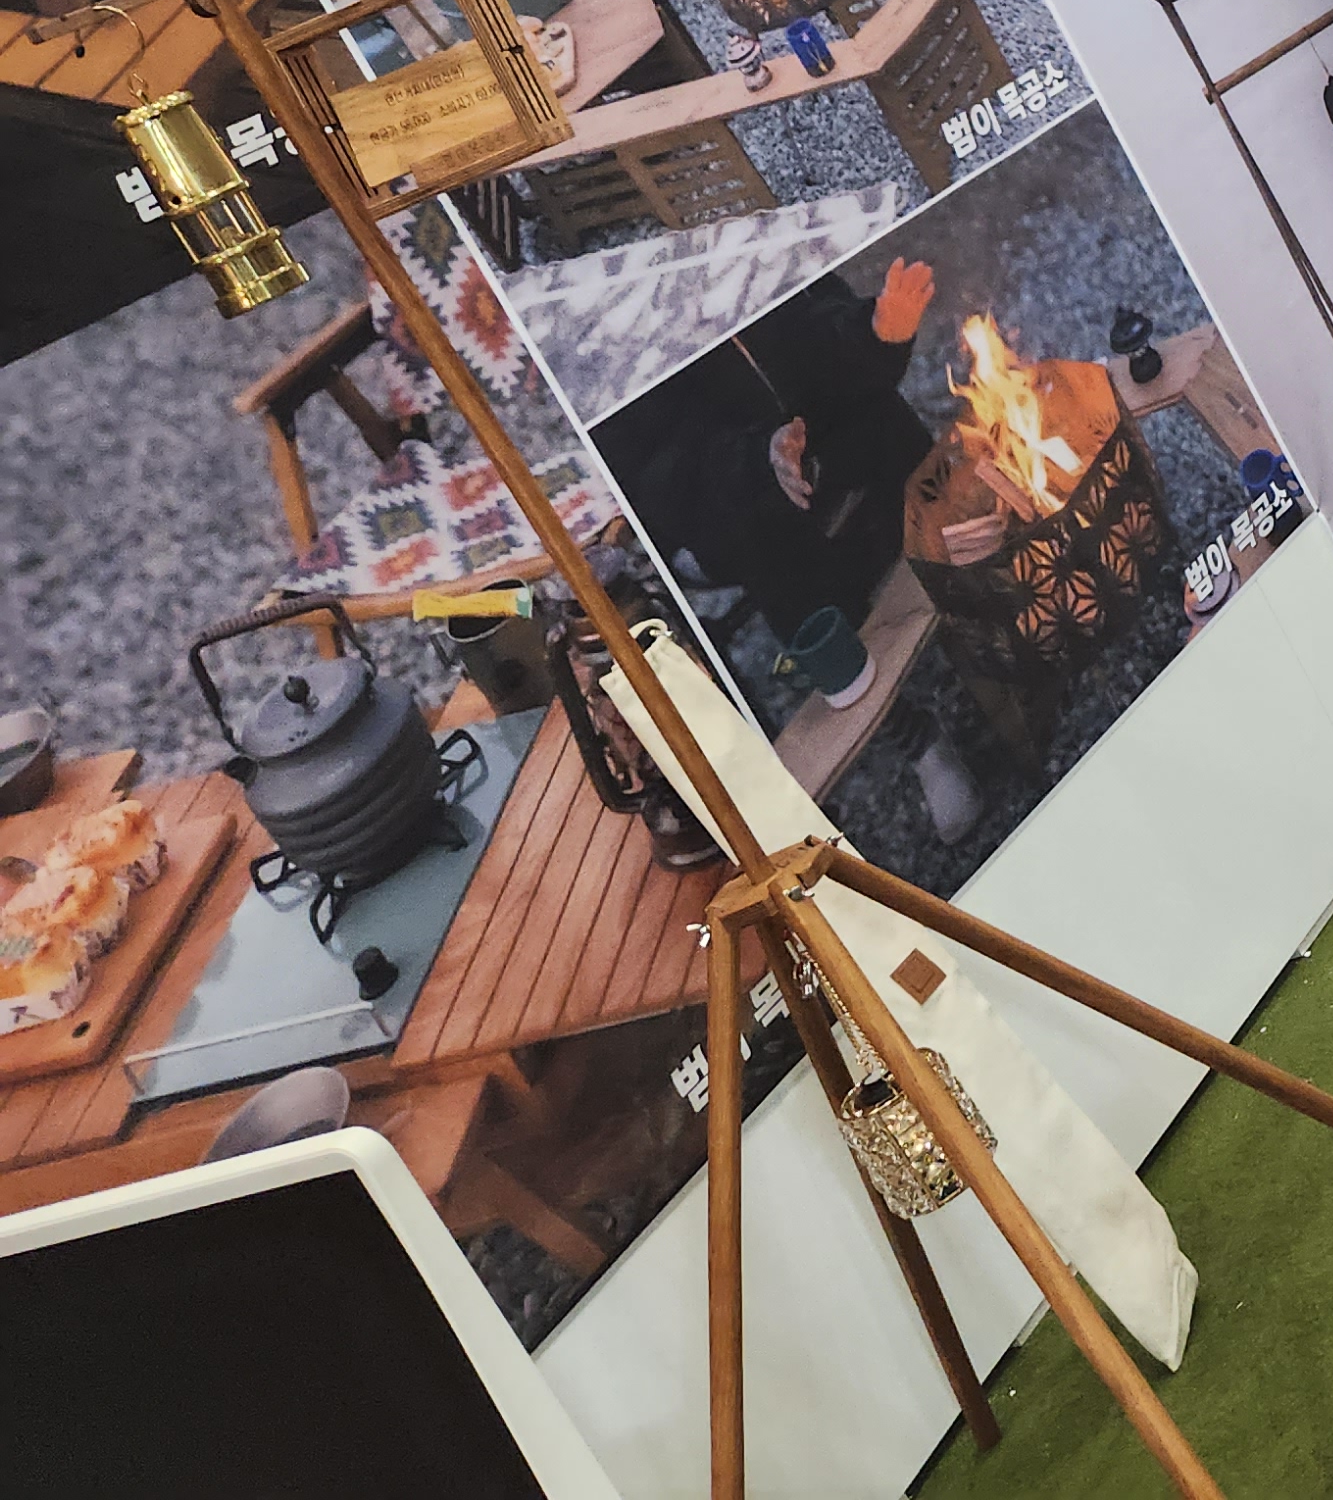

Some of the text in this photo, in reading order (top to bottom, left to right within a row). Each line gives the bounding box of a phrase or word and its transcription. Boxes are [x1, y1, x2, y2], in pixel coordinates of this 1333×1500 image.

[941, 60, 1069, 159] 범이 목공소
[1185, 481, 1293, 602] 범이 목공소
